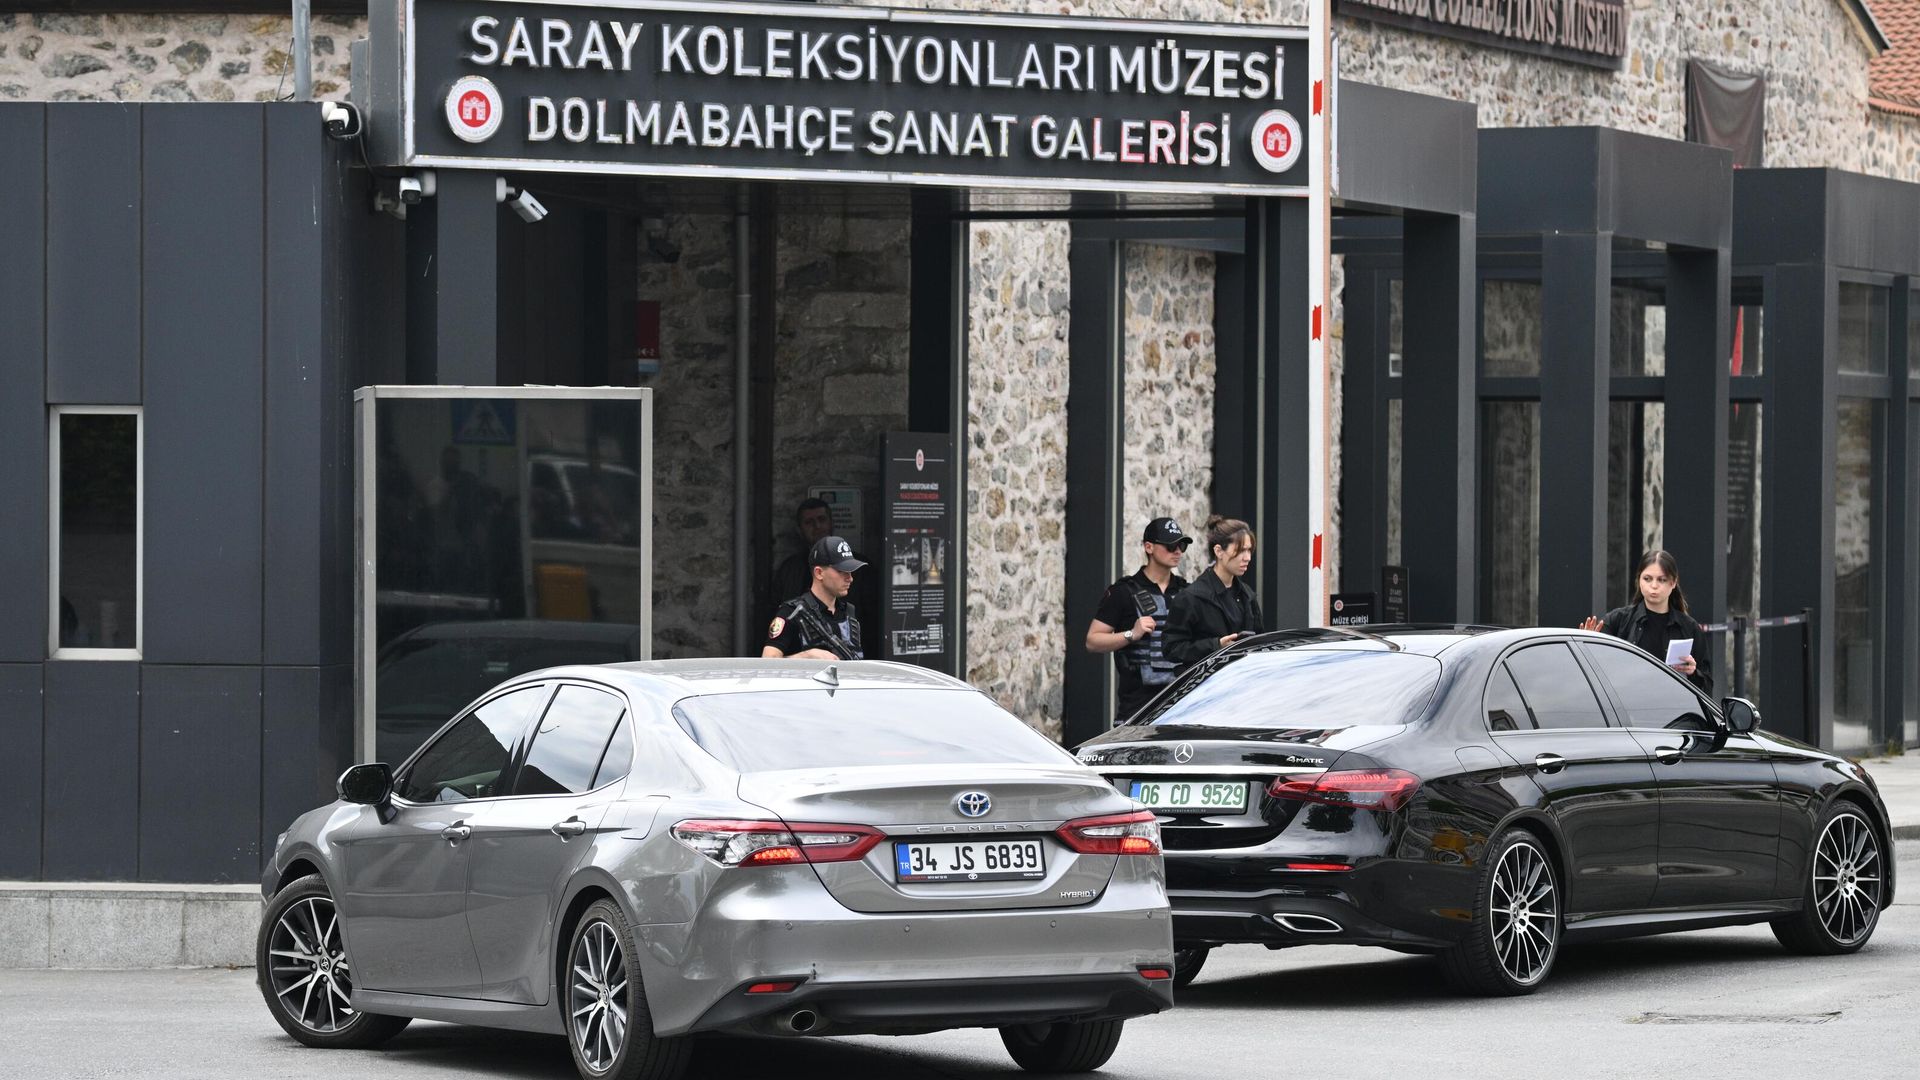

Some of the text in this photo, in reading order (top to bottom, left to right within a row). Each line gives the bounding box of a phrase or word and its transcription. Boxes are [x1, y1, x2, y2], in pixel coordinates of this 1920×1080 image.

[1561, 0, 1628, 57] MUSEUM
[470, 16, 1285, 100] SARAY KOLEKSİYONLARI MÜZESİ
[528, 96, 1231, 167] DOLMABAHÇE SANAT GALERİSİ
[1076, 754, 1104, 762] 300d
[1286, 755, 1324, 764] 4MATIC
[1140, 784, 1244, 806] 06 CD 9529
[916, 823, 1032, 833] CAMRY
[900, 844, 1038, 872] TR 34 JS 6839
[1060, 890, 1090, 898] HYBRID
